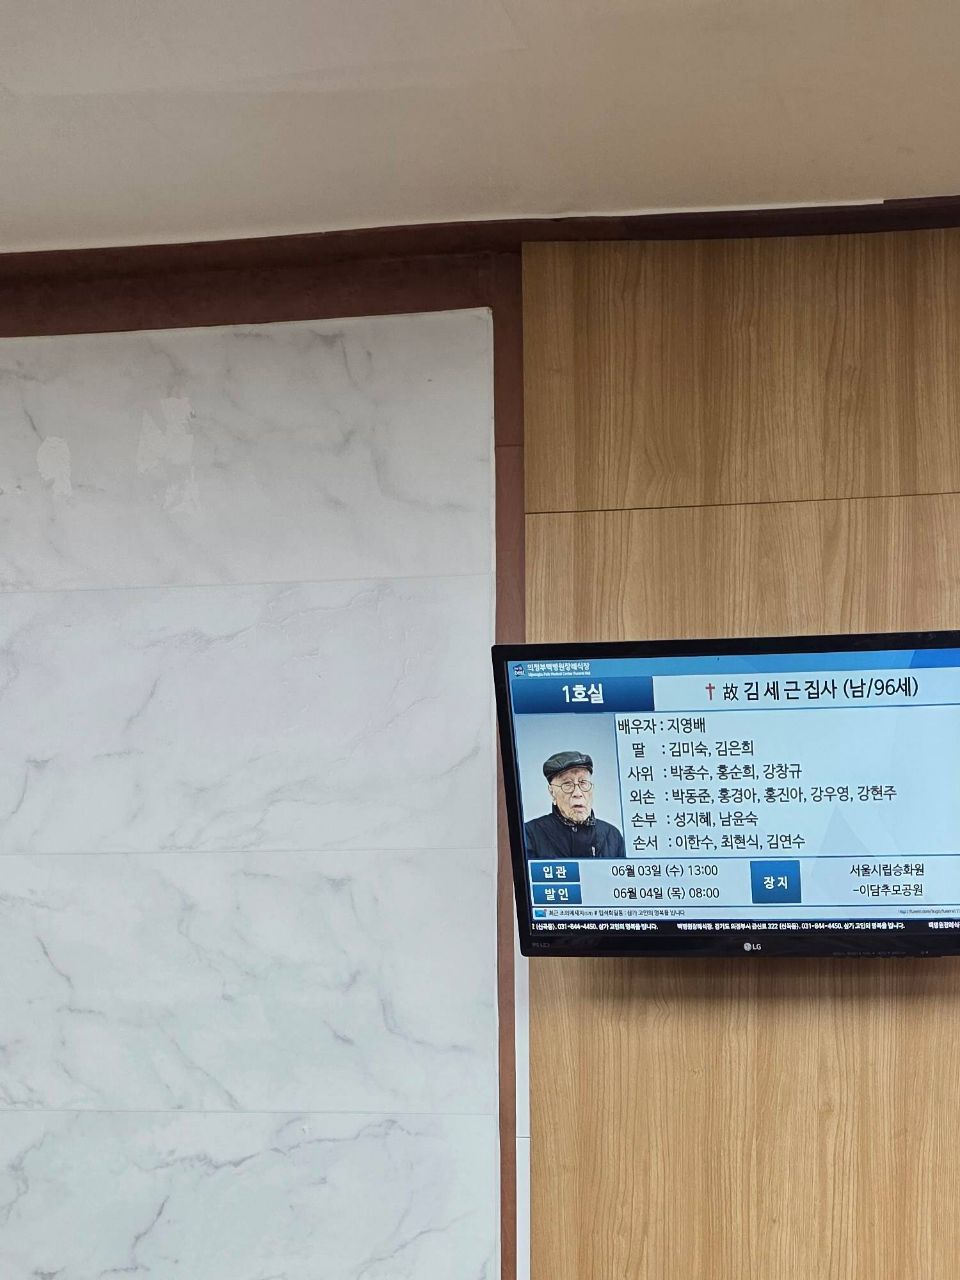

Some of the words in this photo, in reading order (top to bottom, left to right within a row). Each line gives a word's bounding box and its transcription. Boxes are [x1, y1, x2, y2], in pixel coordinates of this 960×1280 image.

[563, 683, 603, 703] 1호실
[723, 683, 739, 701] 故
[844, 677, 918, 698] (남/96세)
[618, 718, 656, 734] 배우자
[668, 717, 705, 733] 지영배
[632, 743, 645, 758] 딸
[669, 741, 711, 757] 김미숙,
[715, 740, 753, 756] 김은희
[628, 766, 653, 781] 사위
[671, 765, 712, 780] 박종수,
[717, 764, 759, 780] 홍순희,
[763, 764, 802, 779] 강창규
[630, 789, 655, 804] 외손
[672, 789, 714, 804] 박동준,
[718, 788, 760, 803] 홍경아,
[764, 787, 806, 803] 홍진아,
[811, 786, 853, 802] 강우영,
[858, 786, 897, 801] 강현주
[631, 813, 657, 827] 손부
[720, 811, 758, 826] 남윤숙
[633, 835, 657, 850] 손서
[676, 835, 717, 850] 이한수,
[767, 834, 805, 849] 김연수
[612, 865, 635, 877] 06월
[638, 865, 661, 876] 03일
[666, 865, 683, 877] (수)
[688, 865, 718, 875] 13:00
[850, 864, 924, 877] 서울시립승화원
[614, 888, 637, 899] 06월
[640, 888, 663, 899] 04일
[667, 887, 685, 899] (목)
[689, 888, 719, 898] 08:00
[752, 943, 762, 951] LG
